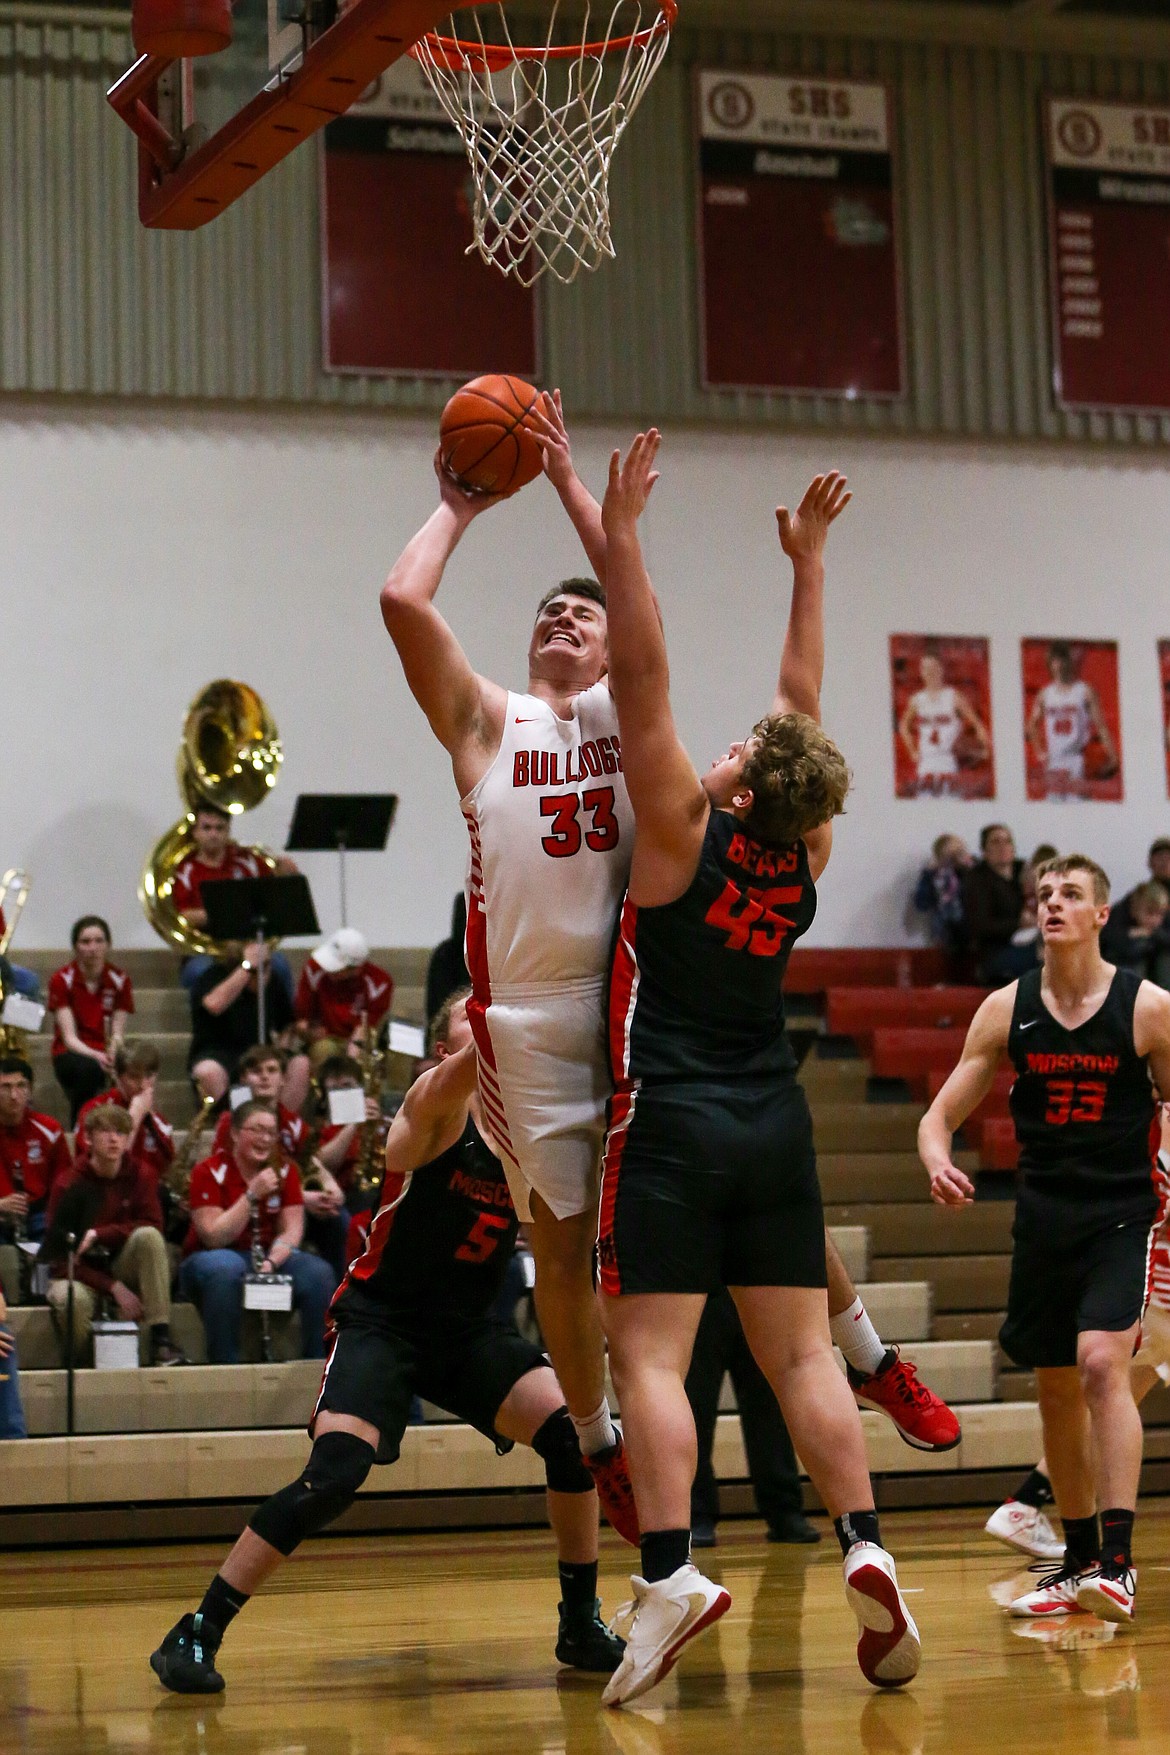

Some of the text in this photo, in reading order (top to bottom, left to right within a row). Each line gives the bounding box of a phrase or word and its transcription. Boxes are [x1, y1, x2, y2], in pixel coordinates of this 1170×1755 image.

[788, 86, 850, 119] SHS
[513, 735, 624, 787] BULLDOGS
[540, 786, 620, 858] 33
[705, 880, 803, 956] 45
[1025, 1052, 1119, 1075] MOSCOW
[1045, 1079, 1108, 1126] 33
[448, 1169, 515, 1210] MOSC
[454, 1211, 510, 1264] 5
